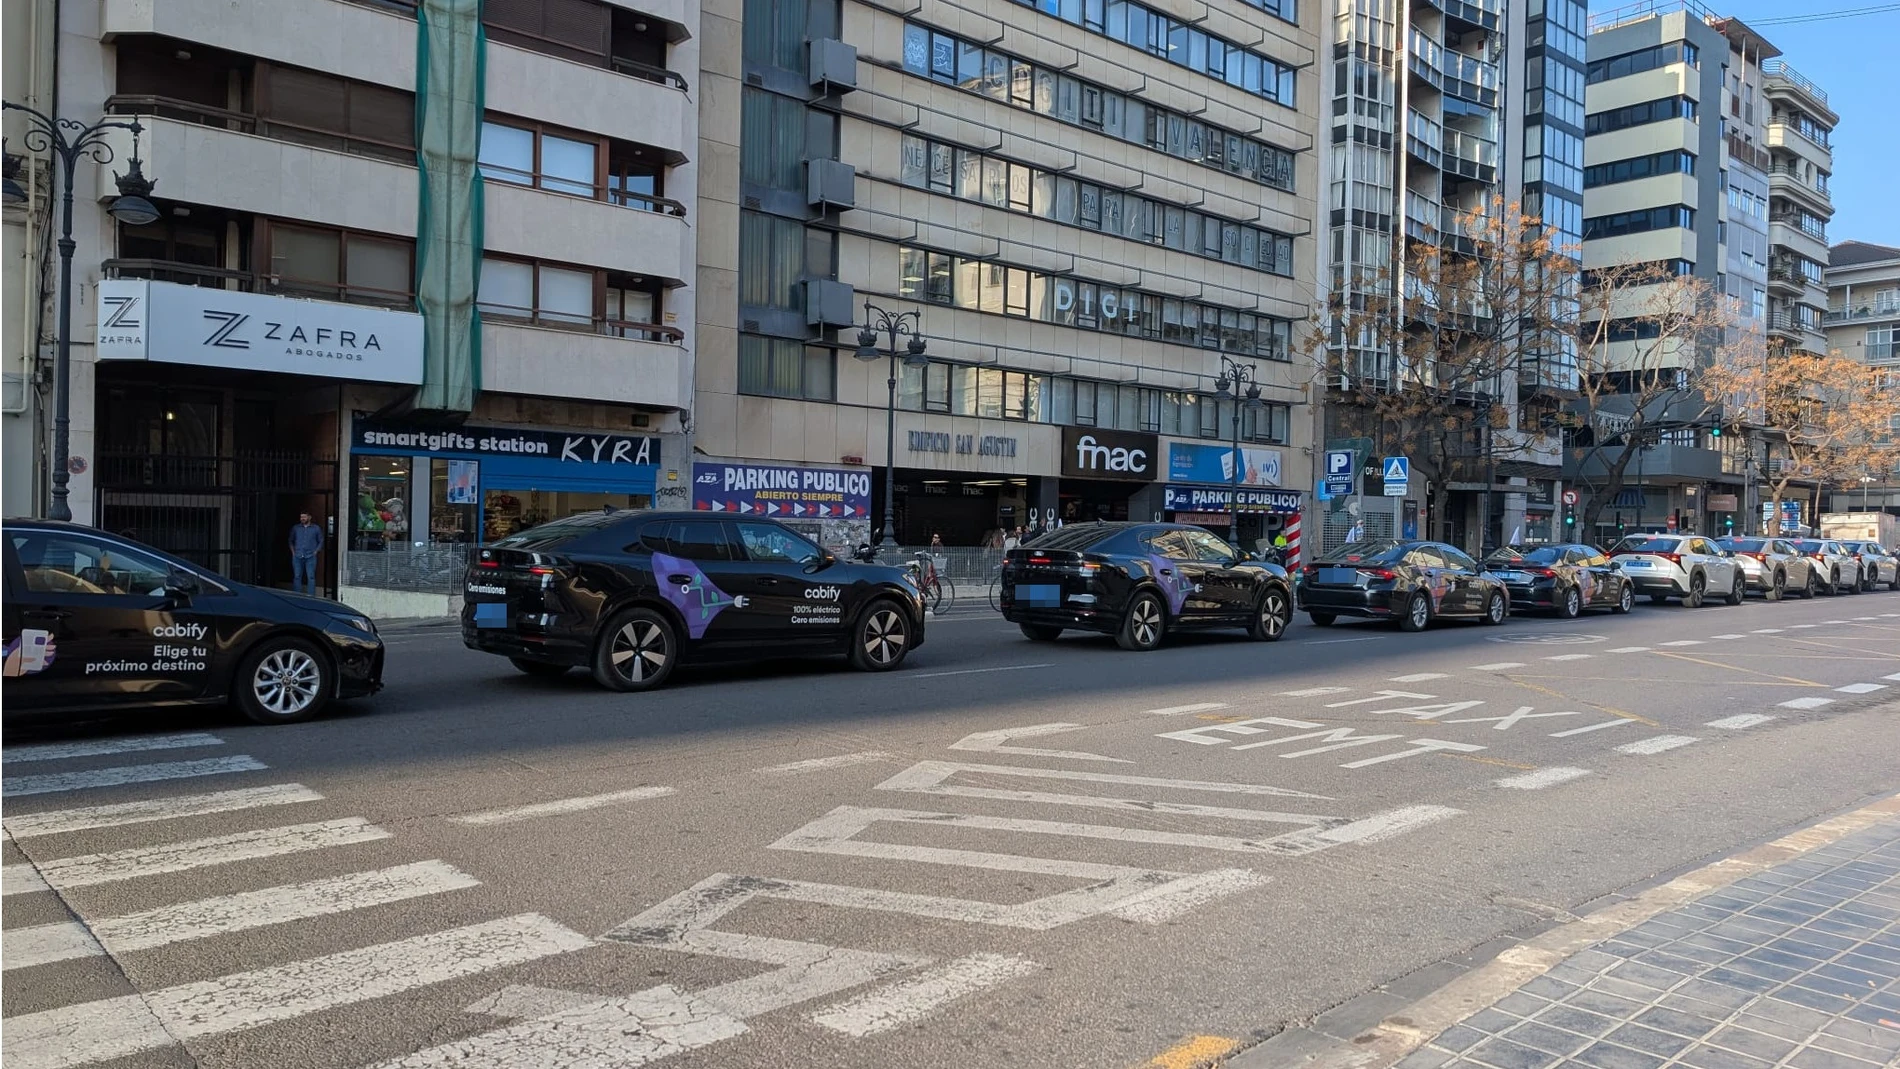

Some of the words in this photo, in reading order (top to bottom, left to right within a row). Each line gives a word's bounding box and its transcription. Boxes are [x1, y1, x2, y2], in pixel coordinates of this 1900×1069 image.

[1171, 116, 1291, 181] VALENCIA
[1083, 193, 1120, 219] PARA
[1168, 214, 1180, 233] LA
[1057, 284, 1134, 323] DIGI
[100, 335, 142, 345] ZAFRA
[264, 322, 381, 351] ZAFRA
[285, 347, 363, 361] ABOGADOS
[363, 431, 475, 451] smartgifts
[479, 437, 549, 454] station
[561, 435, 651, 466] KYRA
[907, 430, 950, 455] EDIFICIO
[955, 434, 972, 455] SAN
[977, 436, 1017, 458] AGUSTIN
[1076, 435, 1147, 473] fnac
[1331, 454, 1347, 473] P
[724, 467, 798, 492] PARKING
[803, 471, 869, 497] PUBLICO
[1328, 475, 1350, 483] Central
[754, 491, 799, 500] ABIERTO
[802, 492, 843, 502] SIEMPRE
[925, 484, 947, 494] fnac
[962, 485, 983, 496] fnac
[1192, 490, 1245, 504] PARKIG
[1248, 492, 1297, 509] PUBLICO
[479, 584, 506, 595] emisiones
[804, 586, 841, 602] cabify
[793, 606, 811, 614] 100%
[812, 606, 841, 614] eléctrico
[791, 616, 807, 624] Cero
[808, 617, 840, 625] emisiones
[153, 623, 208, 640] cabify
[153, 645, 189, 658] Elige
[192, 646, 206, 657] tu
[85, 659, 148, 674] próximo
[151, 659, 206, 671] destino
[1325, 689, 1636, 738] TAXI
[1155, 716, 1489, 768] EMT
